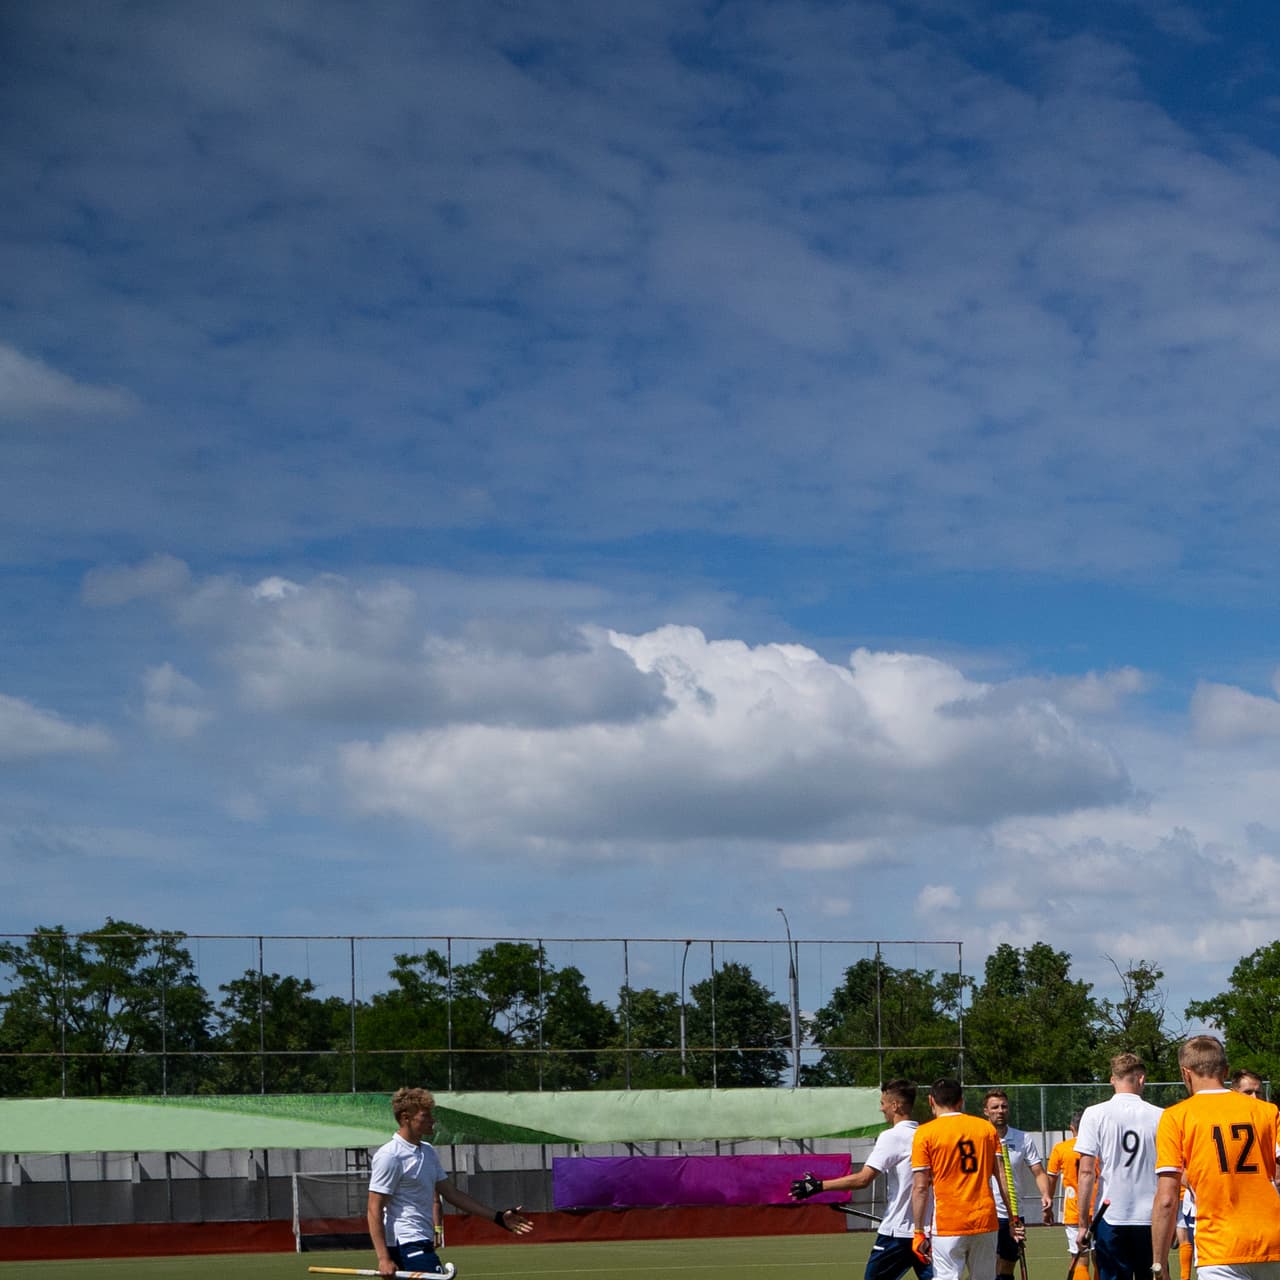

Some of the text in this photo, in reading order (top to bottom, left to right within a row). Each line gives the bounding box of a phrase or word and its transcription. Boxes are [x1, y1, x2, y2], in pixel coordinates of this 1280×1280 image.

[957, 1139, 978, 1174] 8
[1122, 1130, 1140, 1167] 9
[1212, 1123, 1260, 1174] 12
